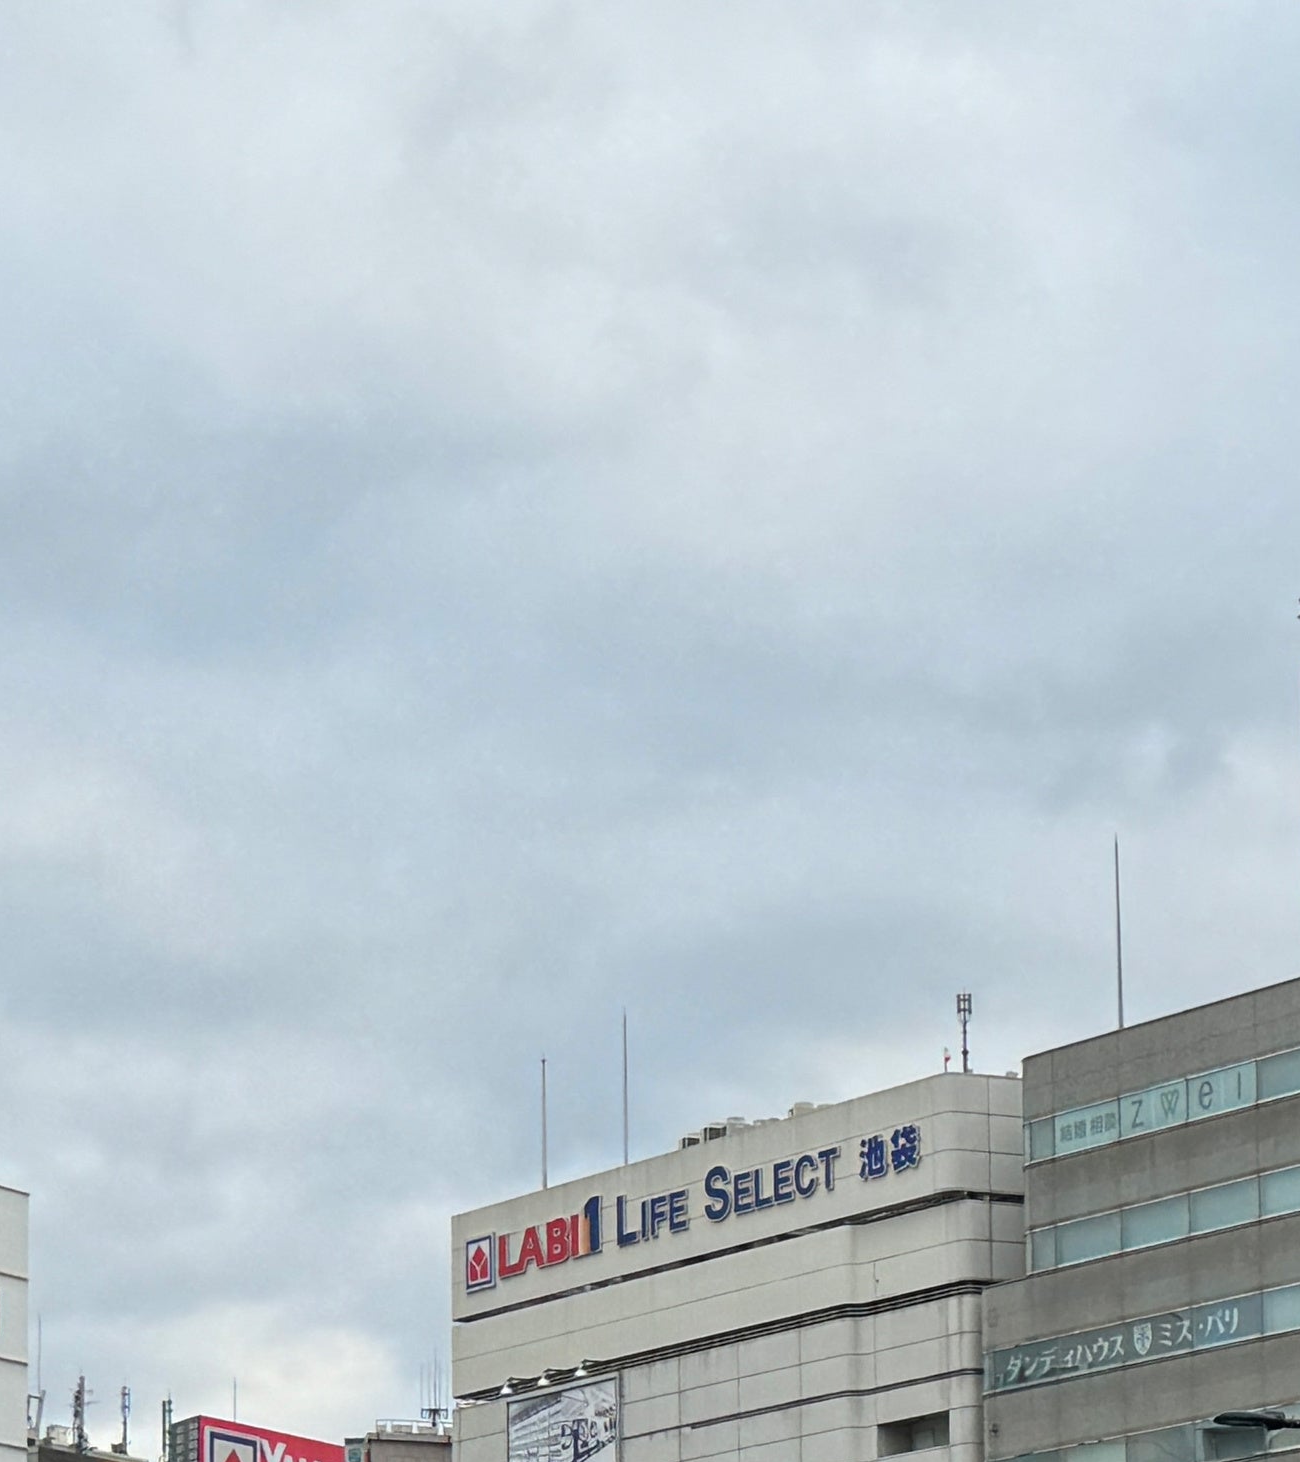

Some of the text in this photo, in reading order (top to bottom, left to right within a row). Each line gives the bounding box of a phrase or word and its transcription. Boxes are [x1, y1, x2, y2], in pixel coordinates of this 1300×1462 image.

[859, 1123, 921, 1182] 池袋
[1006, 1306, 1241, 1382] ダンディハウス ミス・パリ
